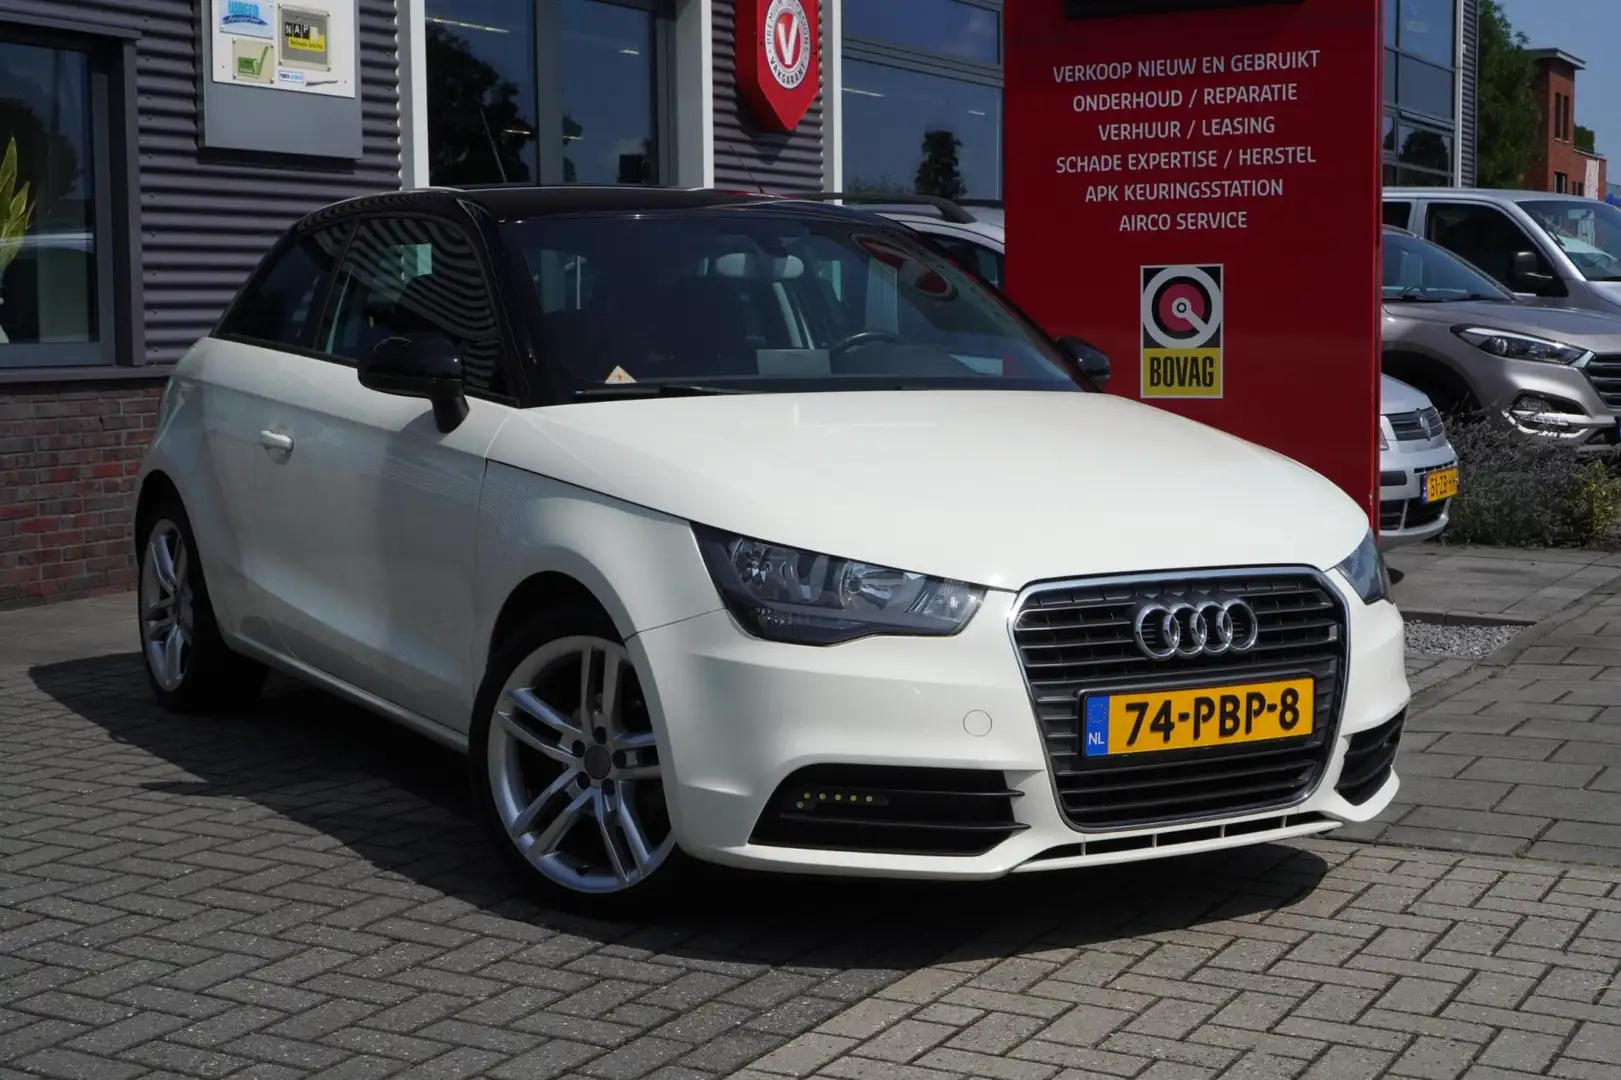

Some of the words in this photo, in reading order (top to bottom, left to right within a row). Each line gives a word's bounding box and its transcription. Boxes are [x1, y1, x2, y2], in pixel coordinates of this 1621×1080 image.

[777, 15, 799, 65] V
[770, 56, 806, 85] VAKGARANT
[1053, 62, 1132, 83] VERKOOP
[1138, 57, 1197, 78] NIEUW
[1202, 56, 1225, 74] EN
[1231, 50, 1320, 72] GEBRUIKT
[1073, 90, 1183, 112] ONDERHOUD
[1188, 88, 1198, 109] /
[1204, 83, 1298, 105] REPARATIE
[1098, 121, 1181, 141] VERHUUR
[1186, 120, 1196, 140] /
[1202, 116, 1275, 136] LEASING
[1056, 154, 1122, 174] SCHADE
[1128, 150, 1218, 171] EXPERTISE
[1223, 149, 1233, 170] /
[1239, 146, 1316, 166] HERSTEL
[1085, 185, 1119, 203] APK
[1124, 179, 1283, 201] KEURINGSSTATION
[1119, 213, 1171, 232] AIRCO
[1176, 211, 1248, 230] SERVICE
[1149, 356, 1214, 387] BOVAG
[1125, 687, 1299, 747] 74-PBP-8
[1088, 732, 1105, 745] NL
